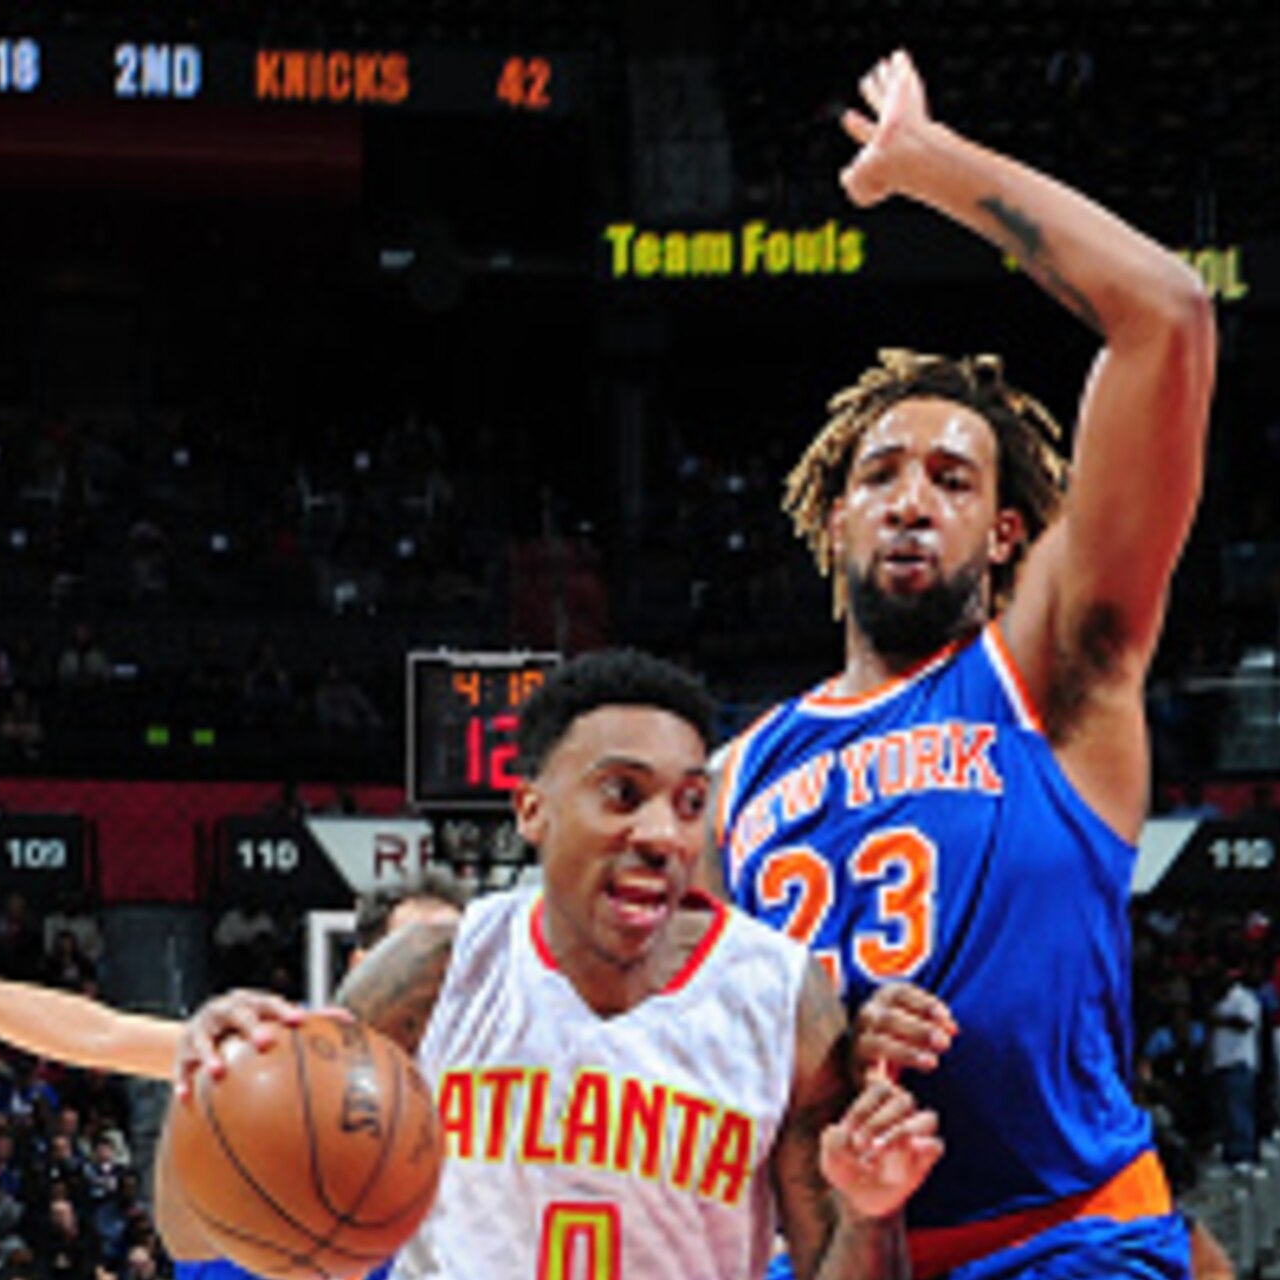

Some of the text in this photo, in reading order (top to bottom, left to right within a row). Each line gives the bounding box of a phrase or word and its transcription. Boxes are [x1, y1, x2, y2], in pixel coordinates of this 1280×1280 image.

[114, 42, 203, 99] 2ND
[255, 49, 410, 104] KNICKS
[496, 56, 552, 108] 42
[604, 219, 864, 277] Team Fouls
[1180, 246, 1248, 299] OL
[465, 714, 522, 790] 12
[839, 717, 1004, 810] YORK
[6, 838, 67, 868] 109
[756, 825, 940, 984] 23
[437, 1065, 754, 1206] ATLANTA
